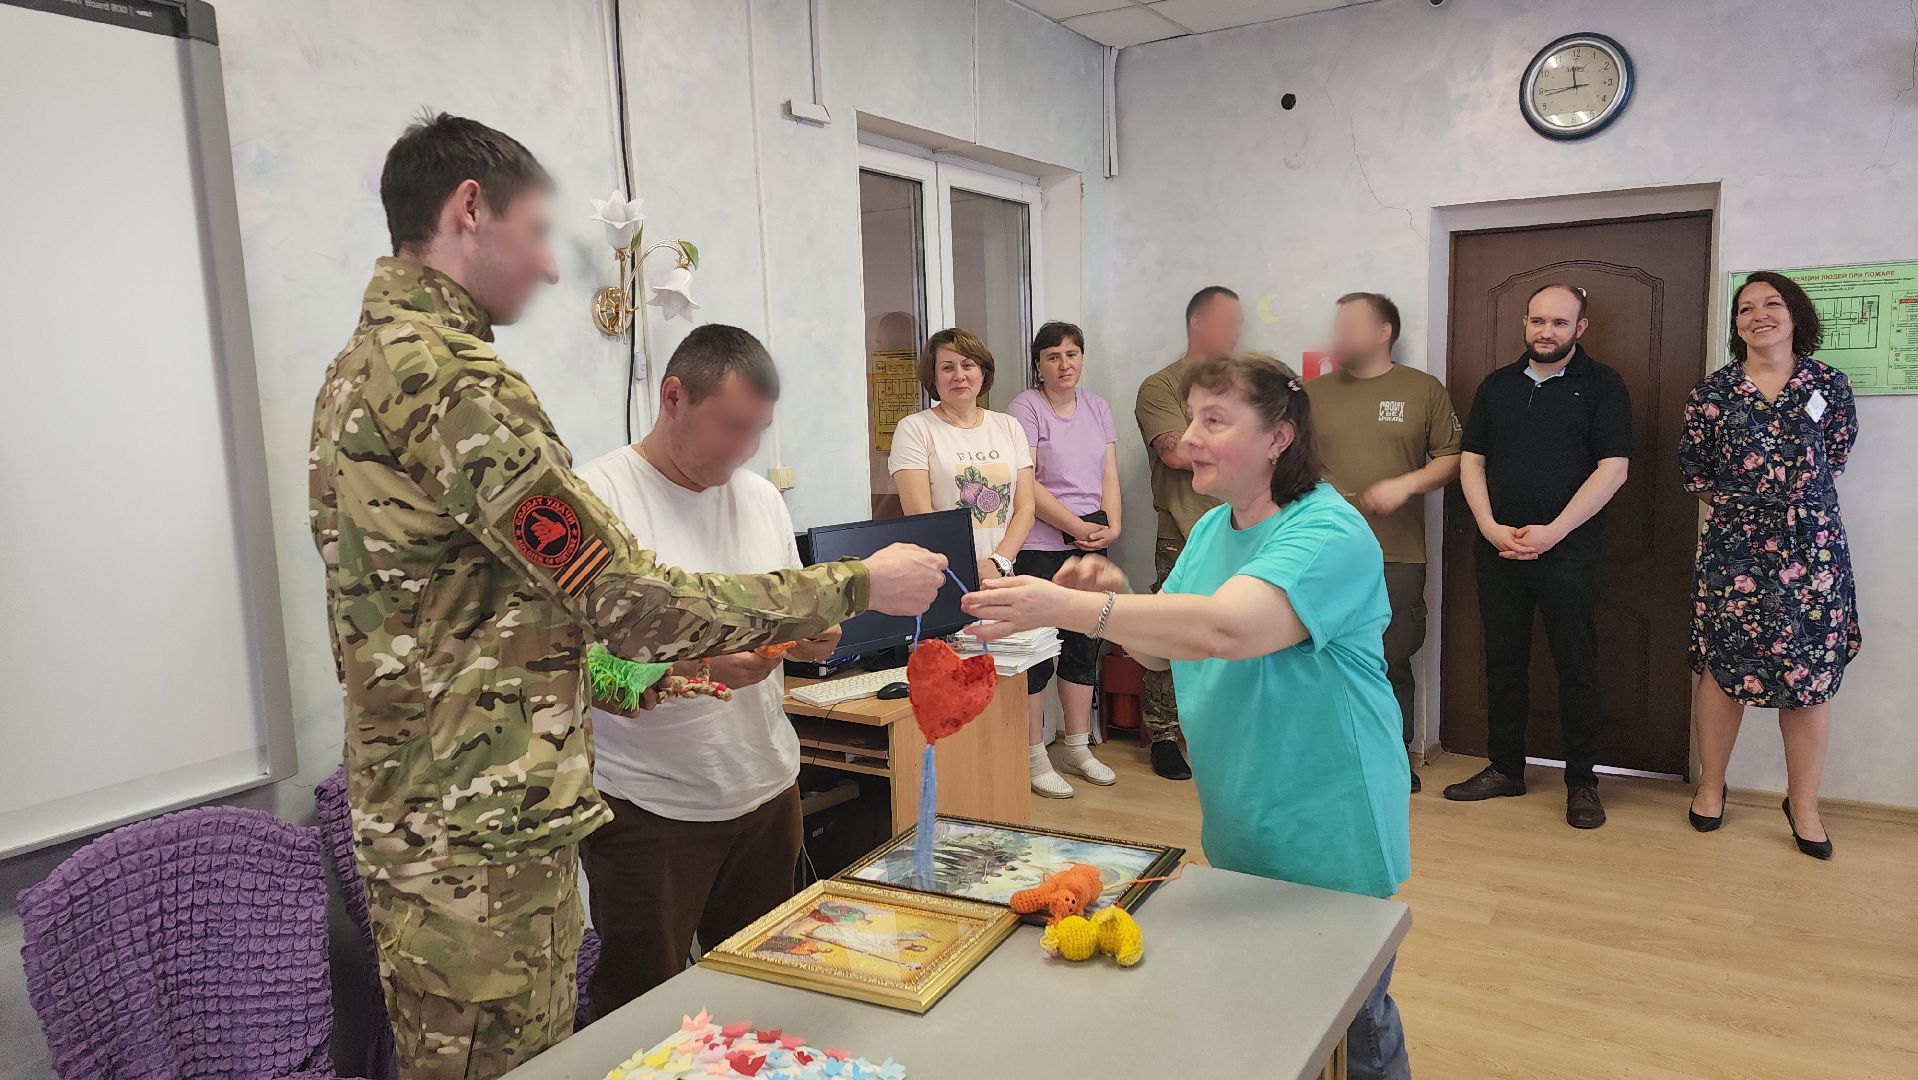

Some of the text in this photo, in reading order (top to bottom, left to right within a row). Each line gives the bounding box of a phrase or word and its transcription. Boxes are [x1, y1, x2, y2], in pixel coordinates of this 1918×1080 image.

[1572, 49, 1580, 58] 12
[1603, 62, 1610, 70] 2
[1538, 87, 1544, 95] 9
[1864, 270, 1895, 278] ПОЖАРЕ
[956, 449, 1000, 461] FIGO
[515, 498, 576, 526] СОЛДАТ УДАЧИ
